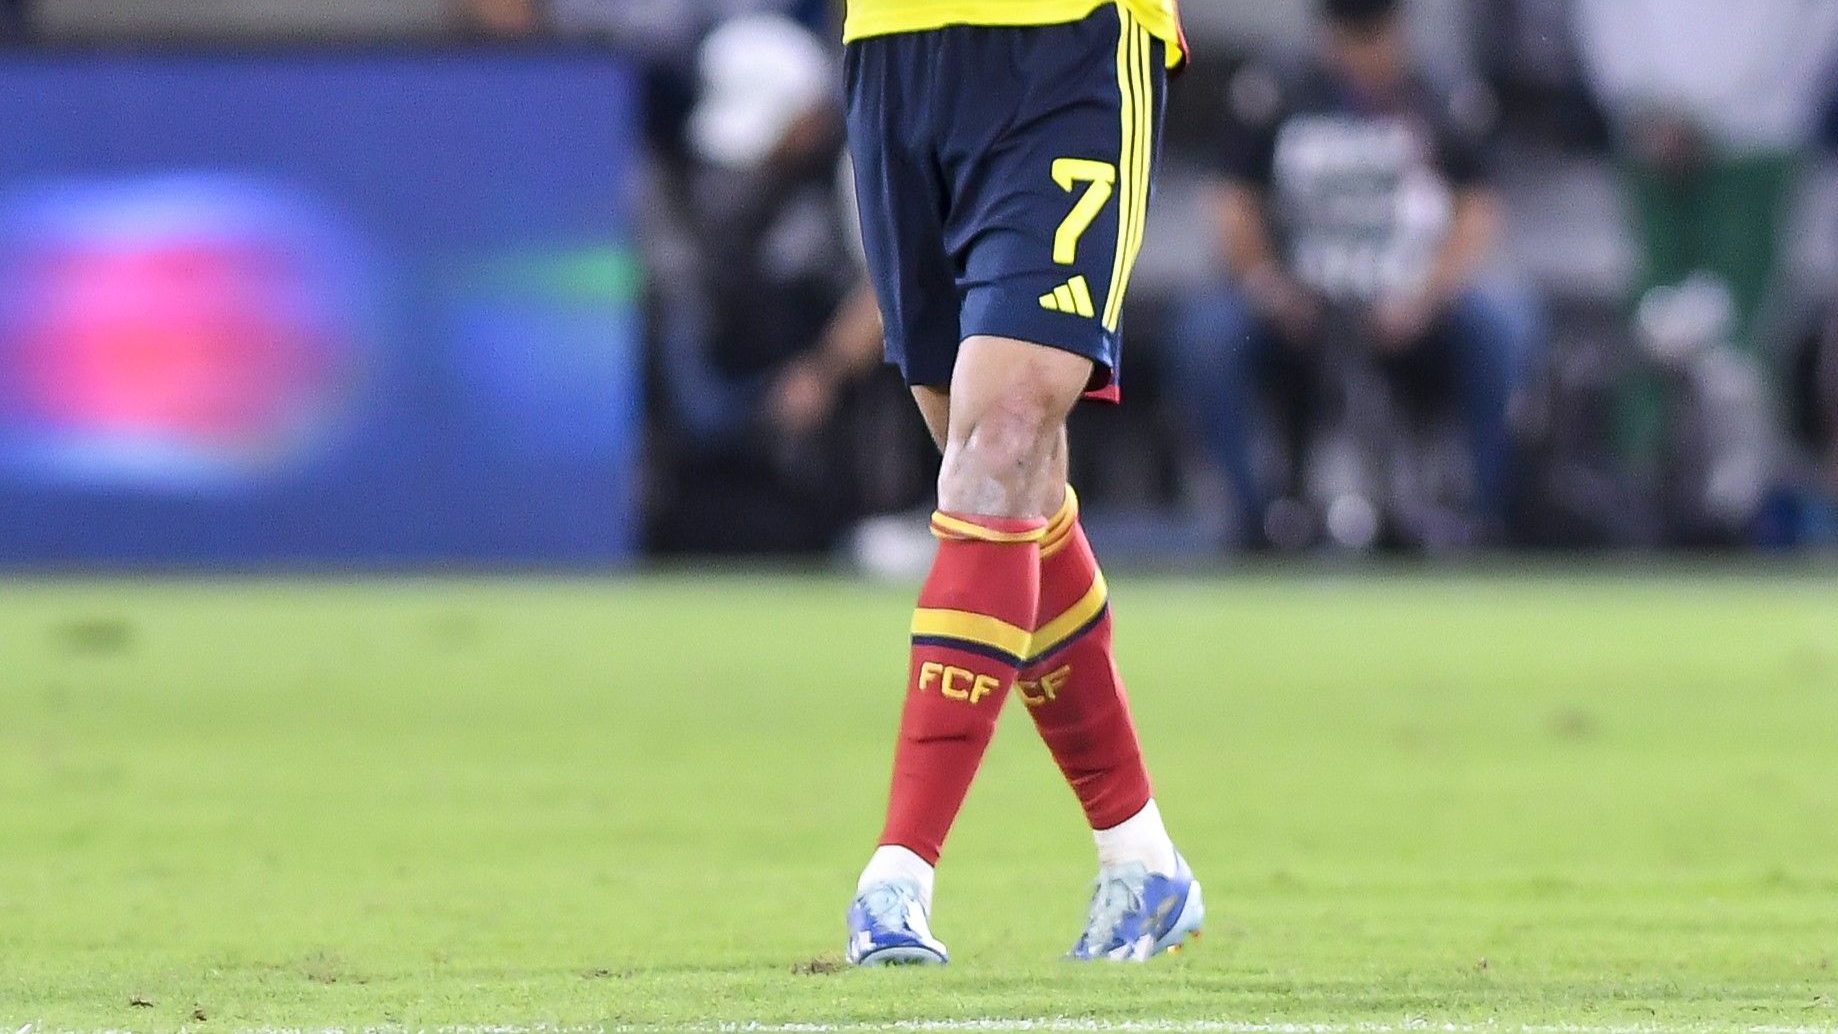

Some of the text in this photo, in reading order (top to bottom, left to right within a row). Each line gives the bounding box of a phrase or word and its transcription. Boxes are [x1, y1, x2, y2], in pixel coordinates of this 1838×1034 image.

[1051, 157, 1116, 265] 7
[918, 661, 1001, 704] FCF
[1017, 664, 1072, 707] CF
